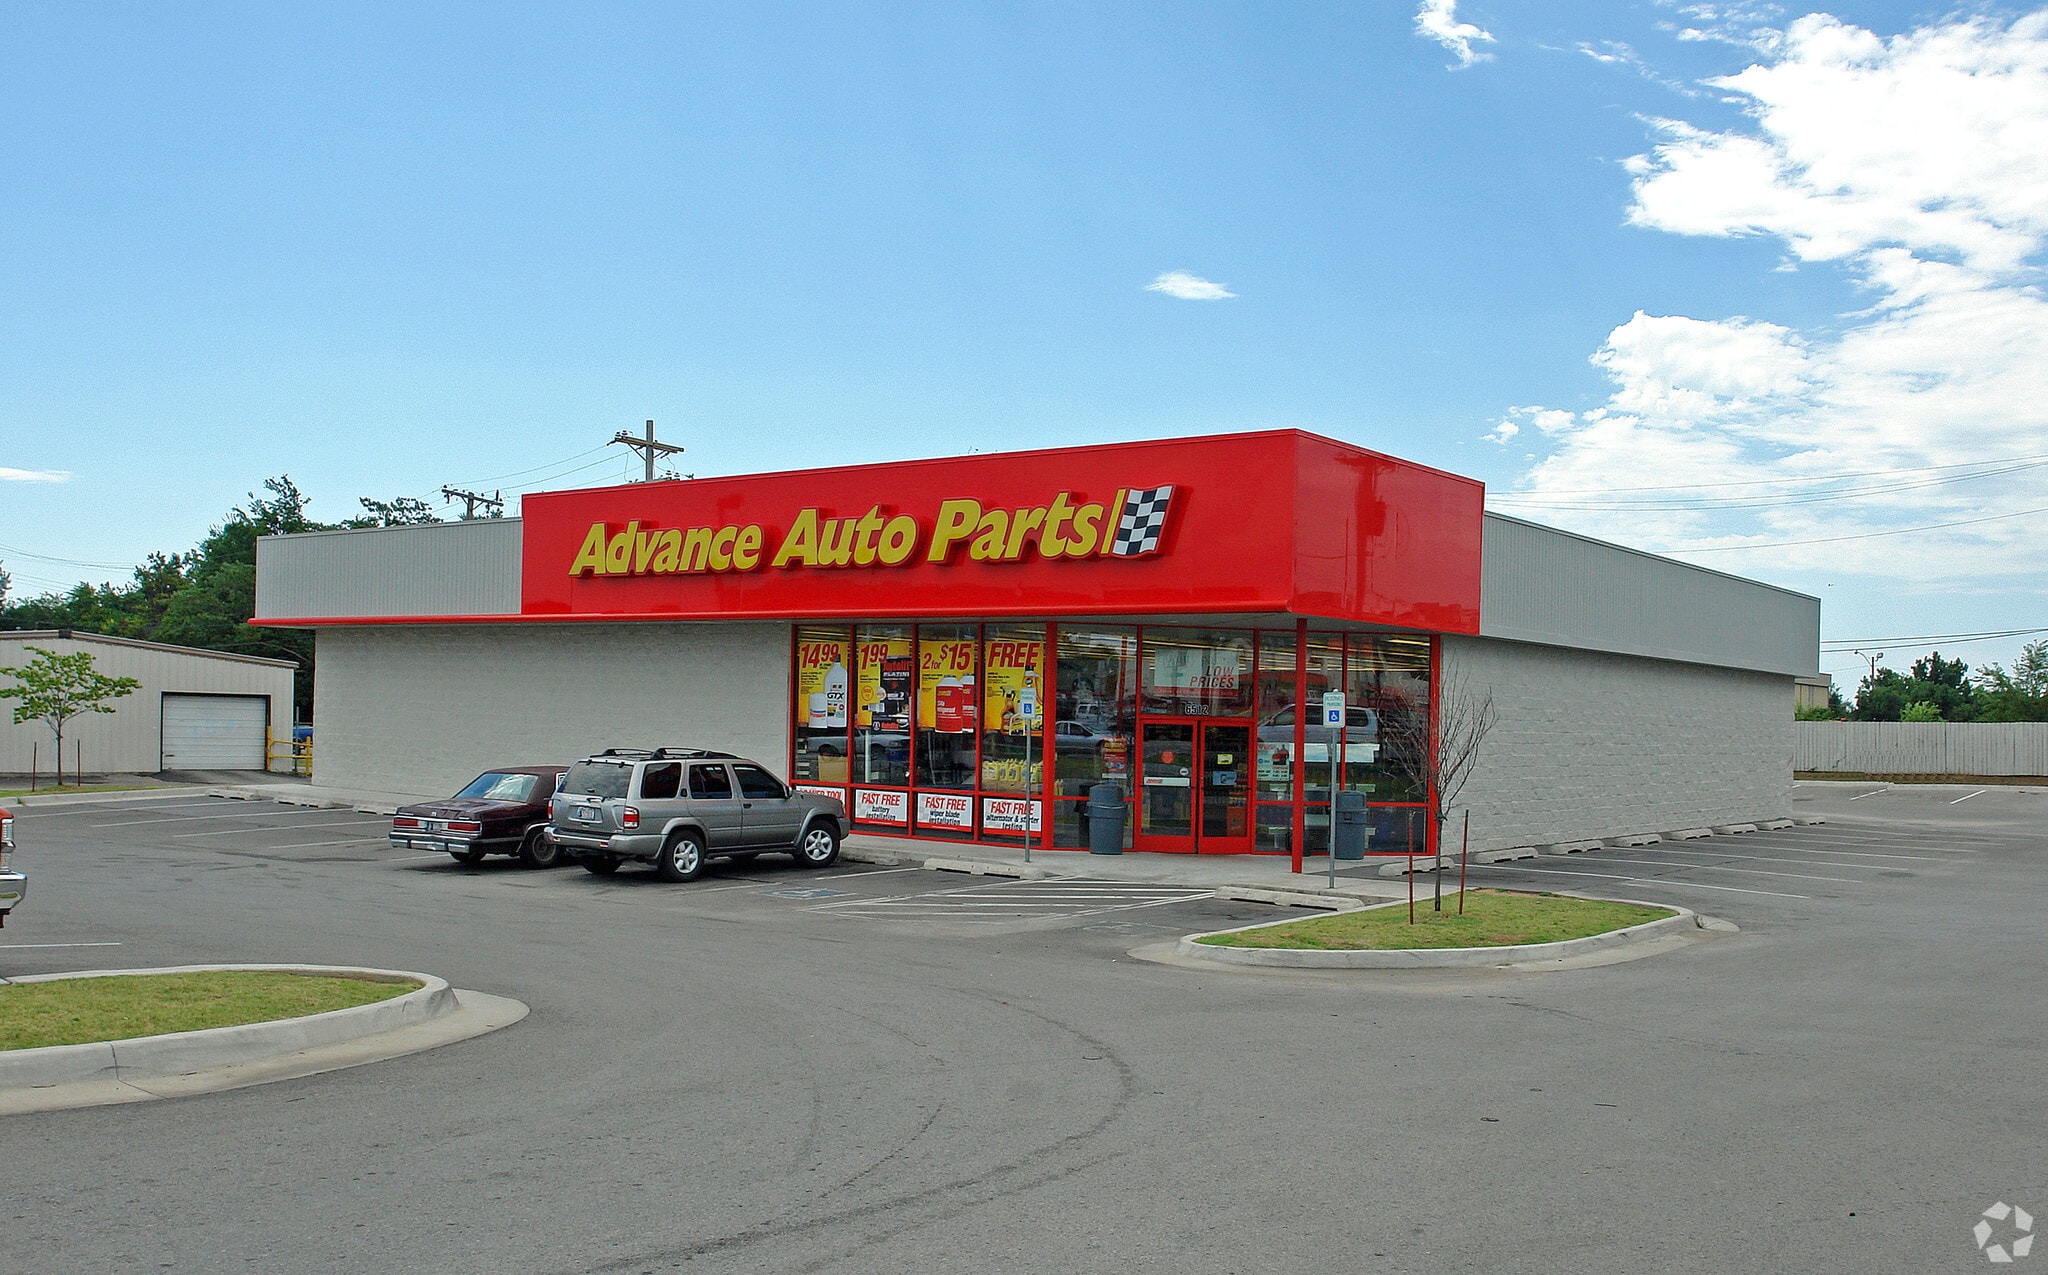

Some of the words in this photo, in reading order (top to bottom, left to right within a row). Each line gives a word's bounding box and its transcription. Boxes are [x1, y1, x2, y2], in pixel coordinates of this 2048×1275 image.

[568, 520, 763, 577] Advance
[771, 504, 918, 567] Auto
[926, 490, 1105, 562] Parts
[921, 652, 933, 670] 2
[931, 660, 942, 670] for
[940, 643, 972, 671] $15
[987, 642, 1040, 668] FREE
[1206, 666, 1234, 677] LOW
[1190, 676, 1235, 688] PRICES
[827, 692, 844, 700] GTX
[1185, 704, 1209, 715] 6512
[861, 792, 881, 804] FAST
[881, 794, 901, 806] FREE
[925, 796, 945, 809] FAST
[946, 798, 967, 811] FREE
[871, 806, 890, 814] battery
[990, 801, 1012, 814] FAST
[865, 811, 896, 820] installation
[929, 817, 961, 825] installation
